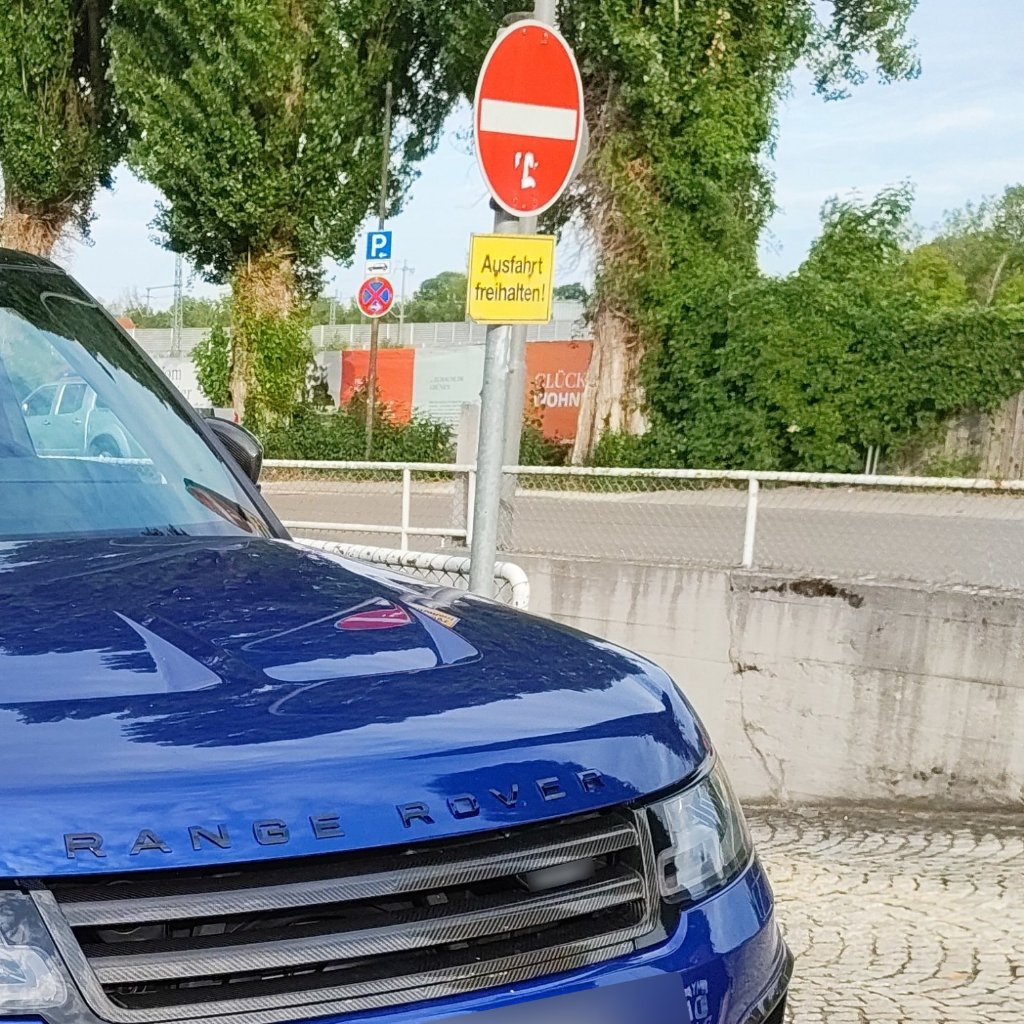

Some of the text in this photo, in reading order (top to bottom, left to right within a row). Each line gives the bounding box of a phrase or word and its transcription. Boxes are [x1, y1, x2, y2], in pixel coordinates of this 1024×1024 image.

[370, 233, 388, 258] P
[480, 254, 544, 275] Ausfahrt
[474, 282, 545, 303] freihalten!
[62, 768, 608, 860] RANGE ROVER
